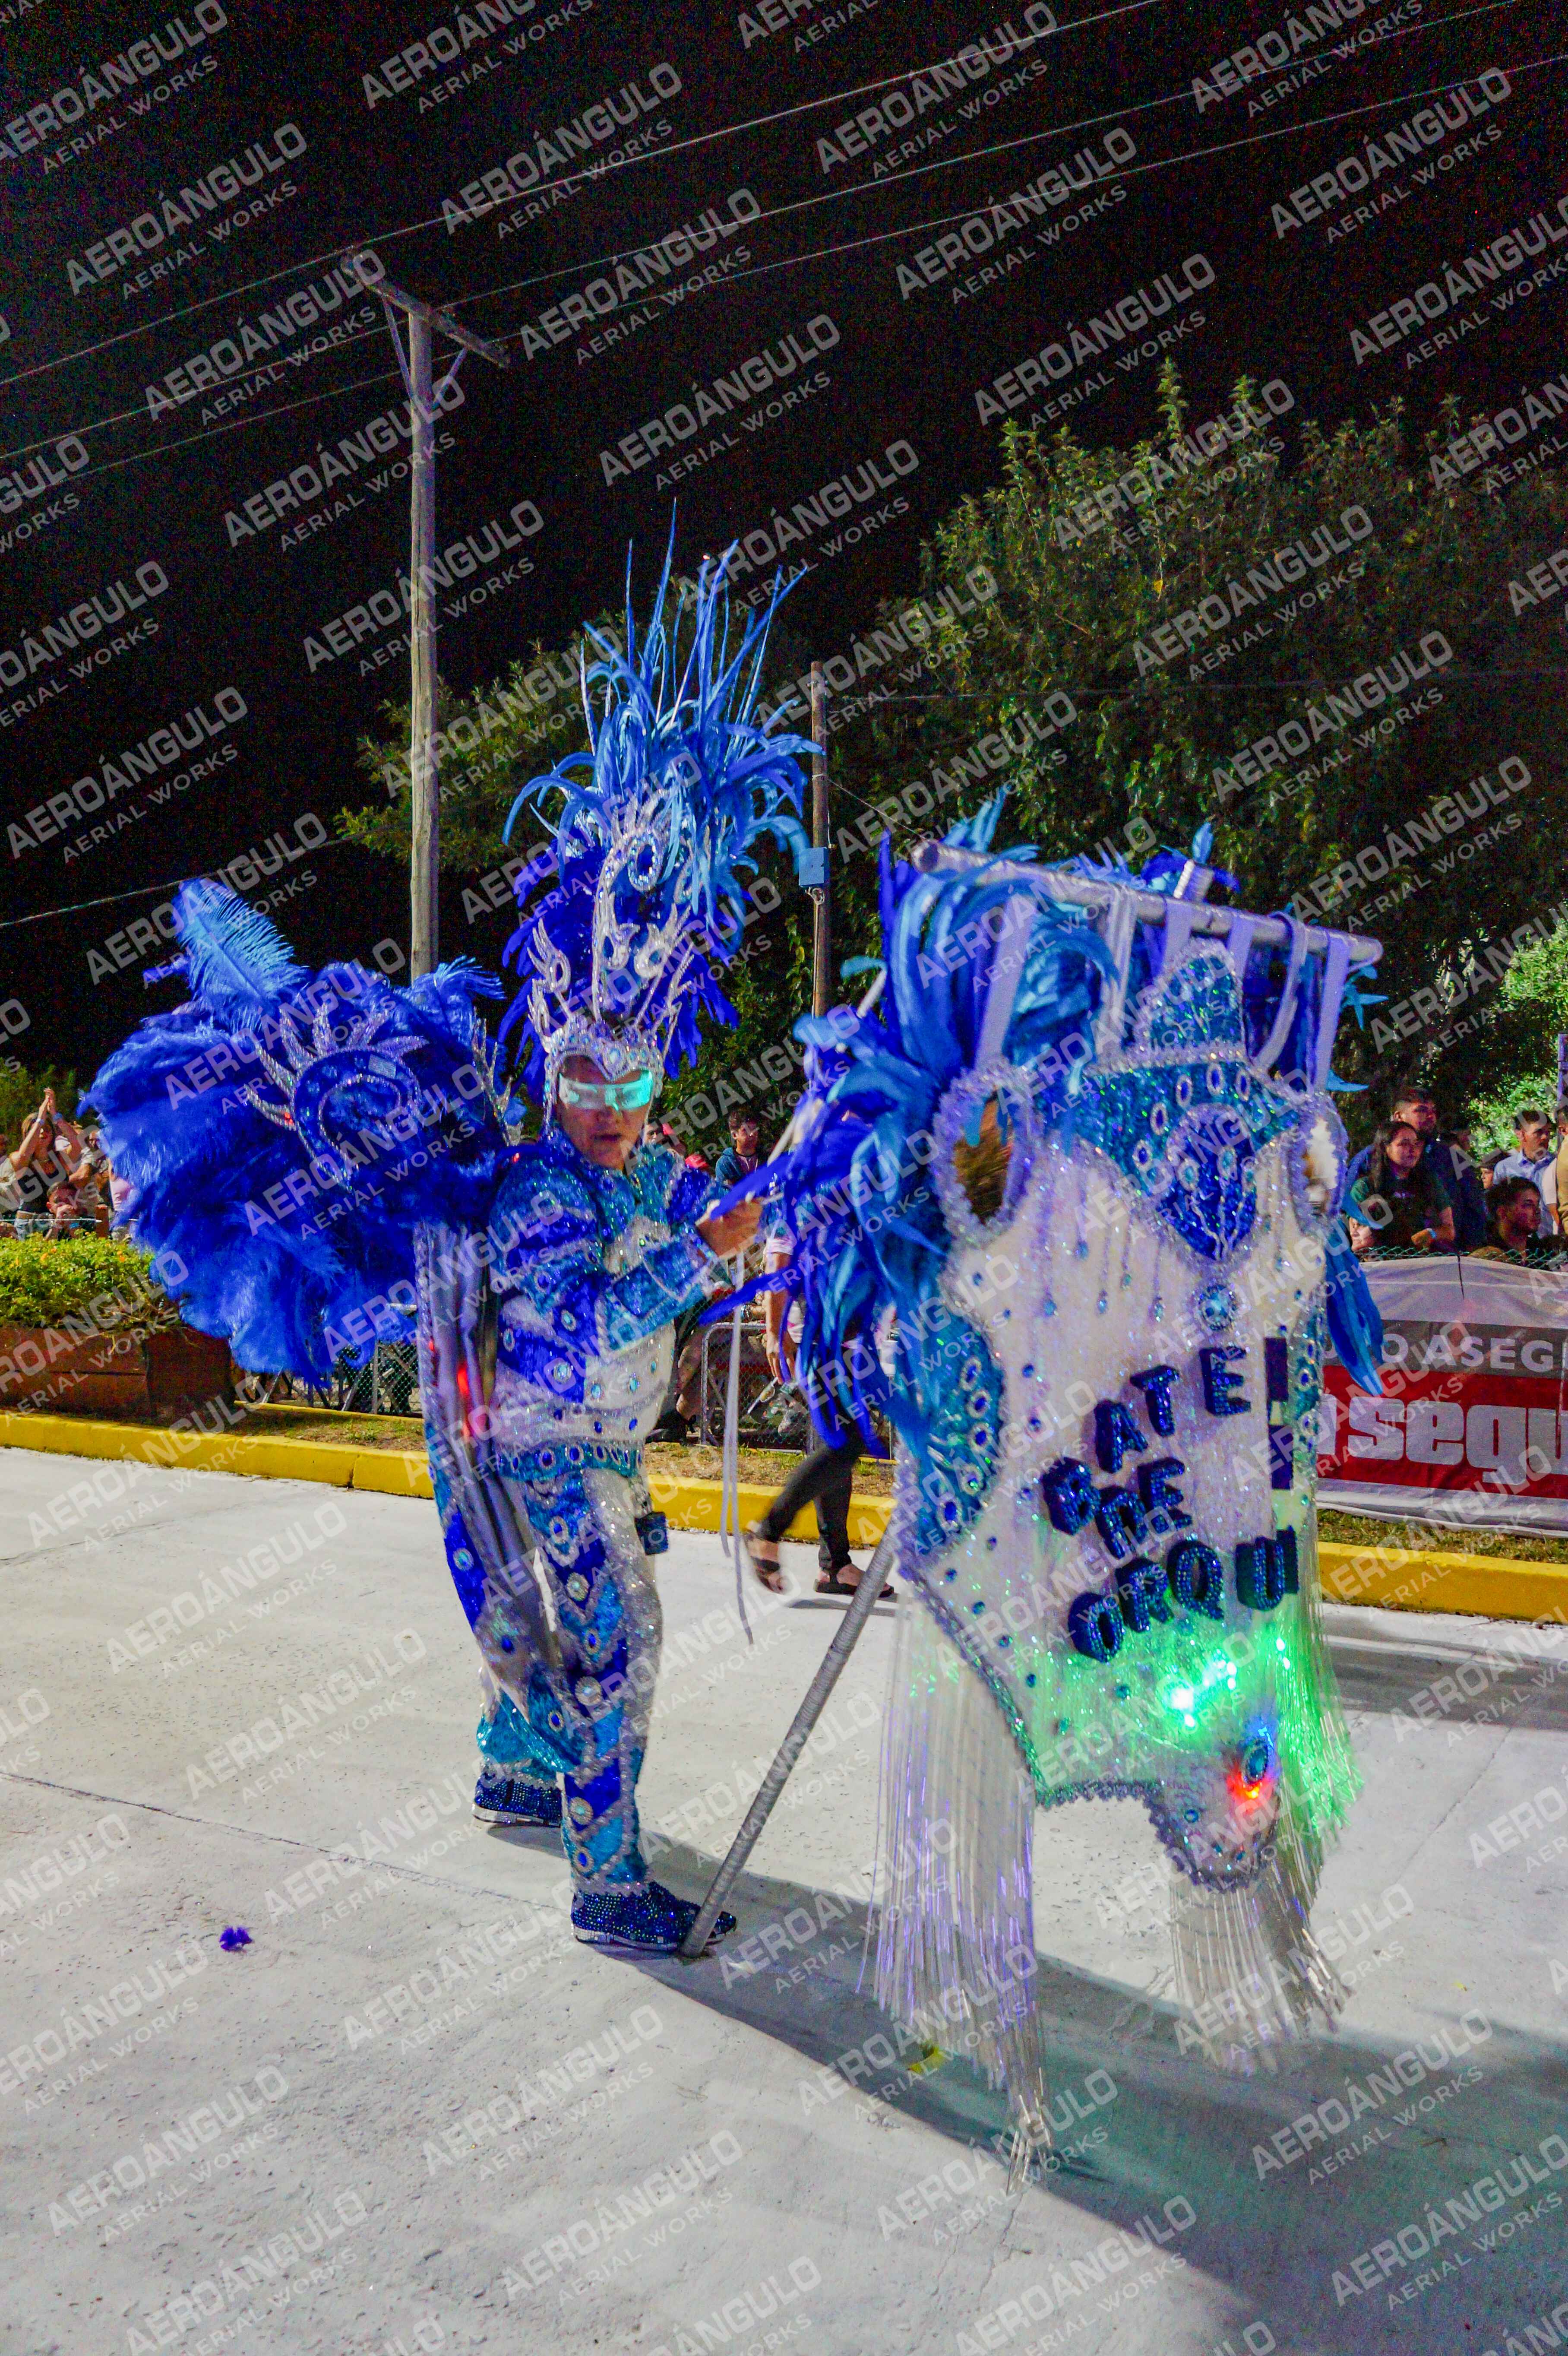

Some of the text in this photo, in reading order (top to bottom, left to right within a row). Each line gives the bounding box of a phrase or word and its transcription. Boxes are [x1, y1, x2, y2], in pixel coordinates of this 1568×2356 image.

[1423, 1334, 1568, 1372] ASEG
[1042, 1338, 1289, 1536] BATE
[1068, 1525, 1299, 1663] ORQU
